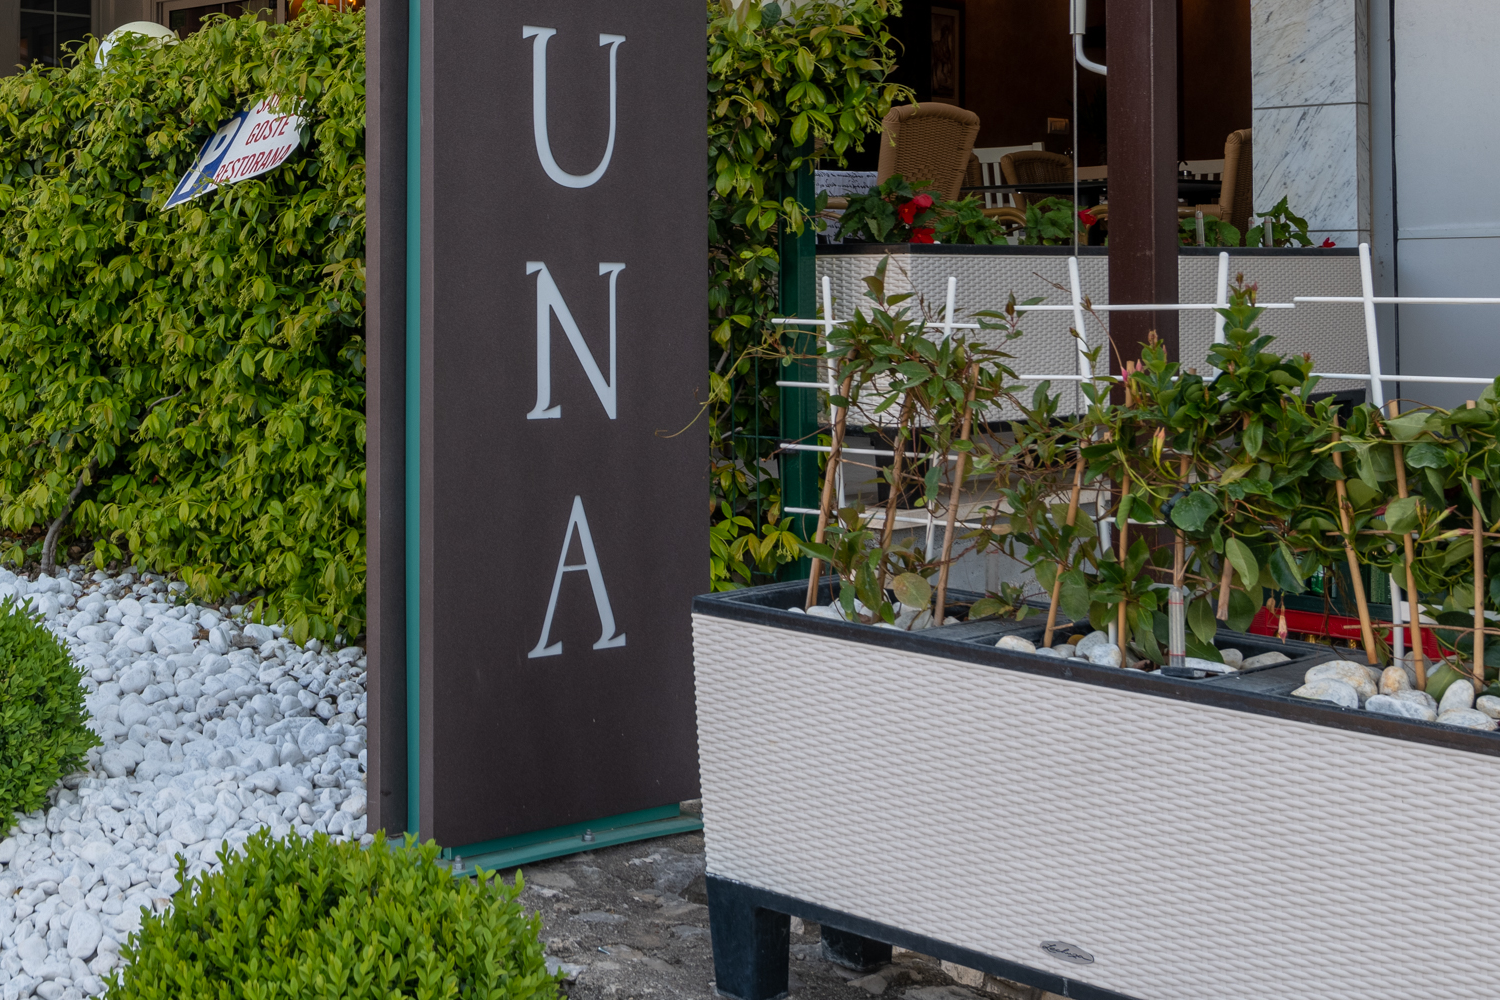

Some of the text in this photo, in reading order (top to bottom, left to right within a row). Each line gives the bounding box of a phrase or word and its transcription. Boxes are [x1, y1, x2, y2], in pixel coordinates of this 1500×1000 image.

[245, 113, 296, 146] GOSTE
[177, 116, 242, 196] P
[210, 143, 293, 187] RESTORANA
